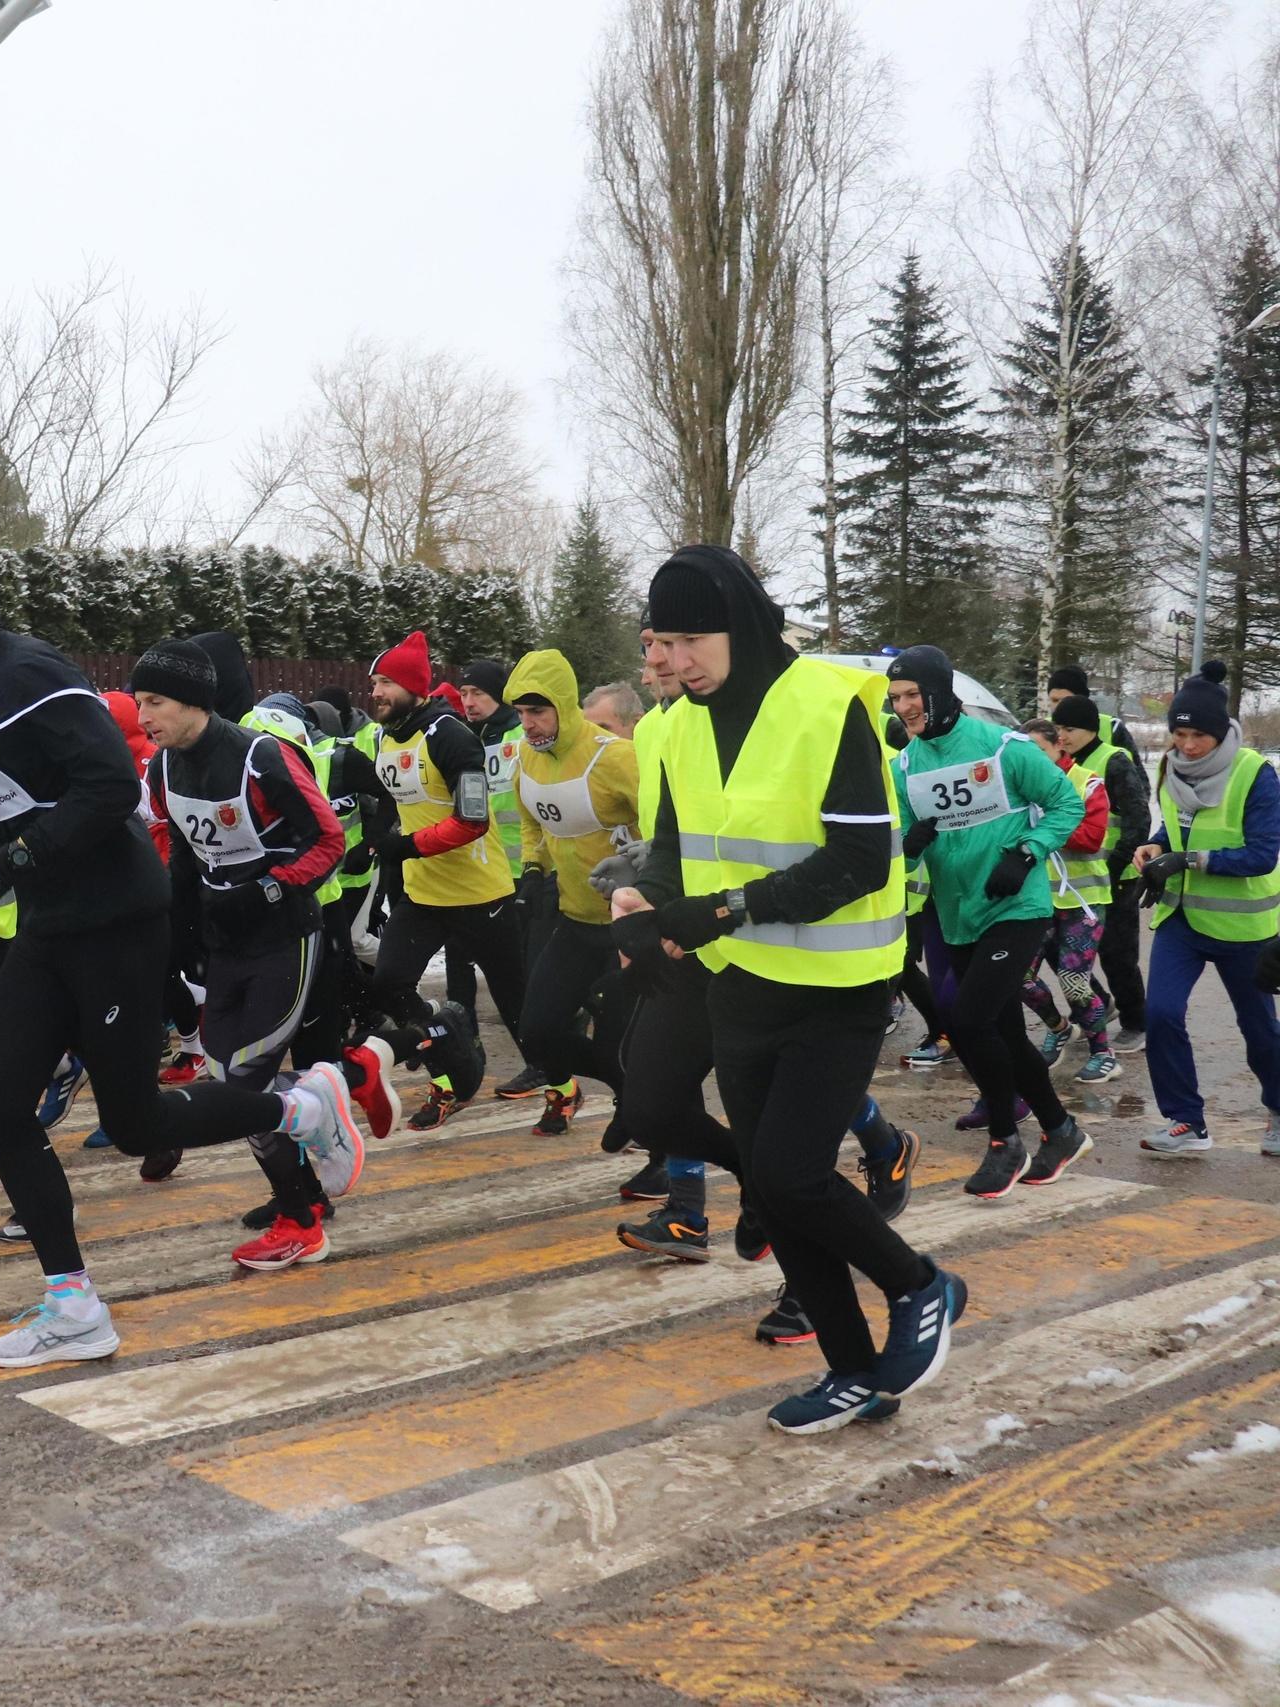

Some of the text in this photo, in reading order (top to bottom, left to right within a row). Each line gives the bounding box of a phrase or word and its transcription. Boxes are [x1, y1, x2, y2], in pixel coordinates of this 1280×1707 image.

[380, 764, 401, 788] 82
[931, 778, 972, 810] 35
[536, 801, 562, 822] 69
[957, 802, 999, 818] городской
[185, 814, 223, 847] 22
